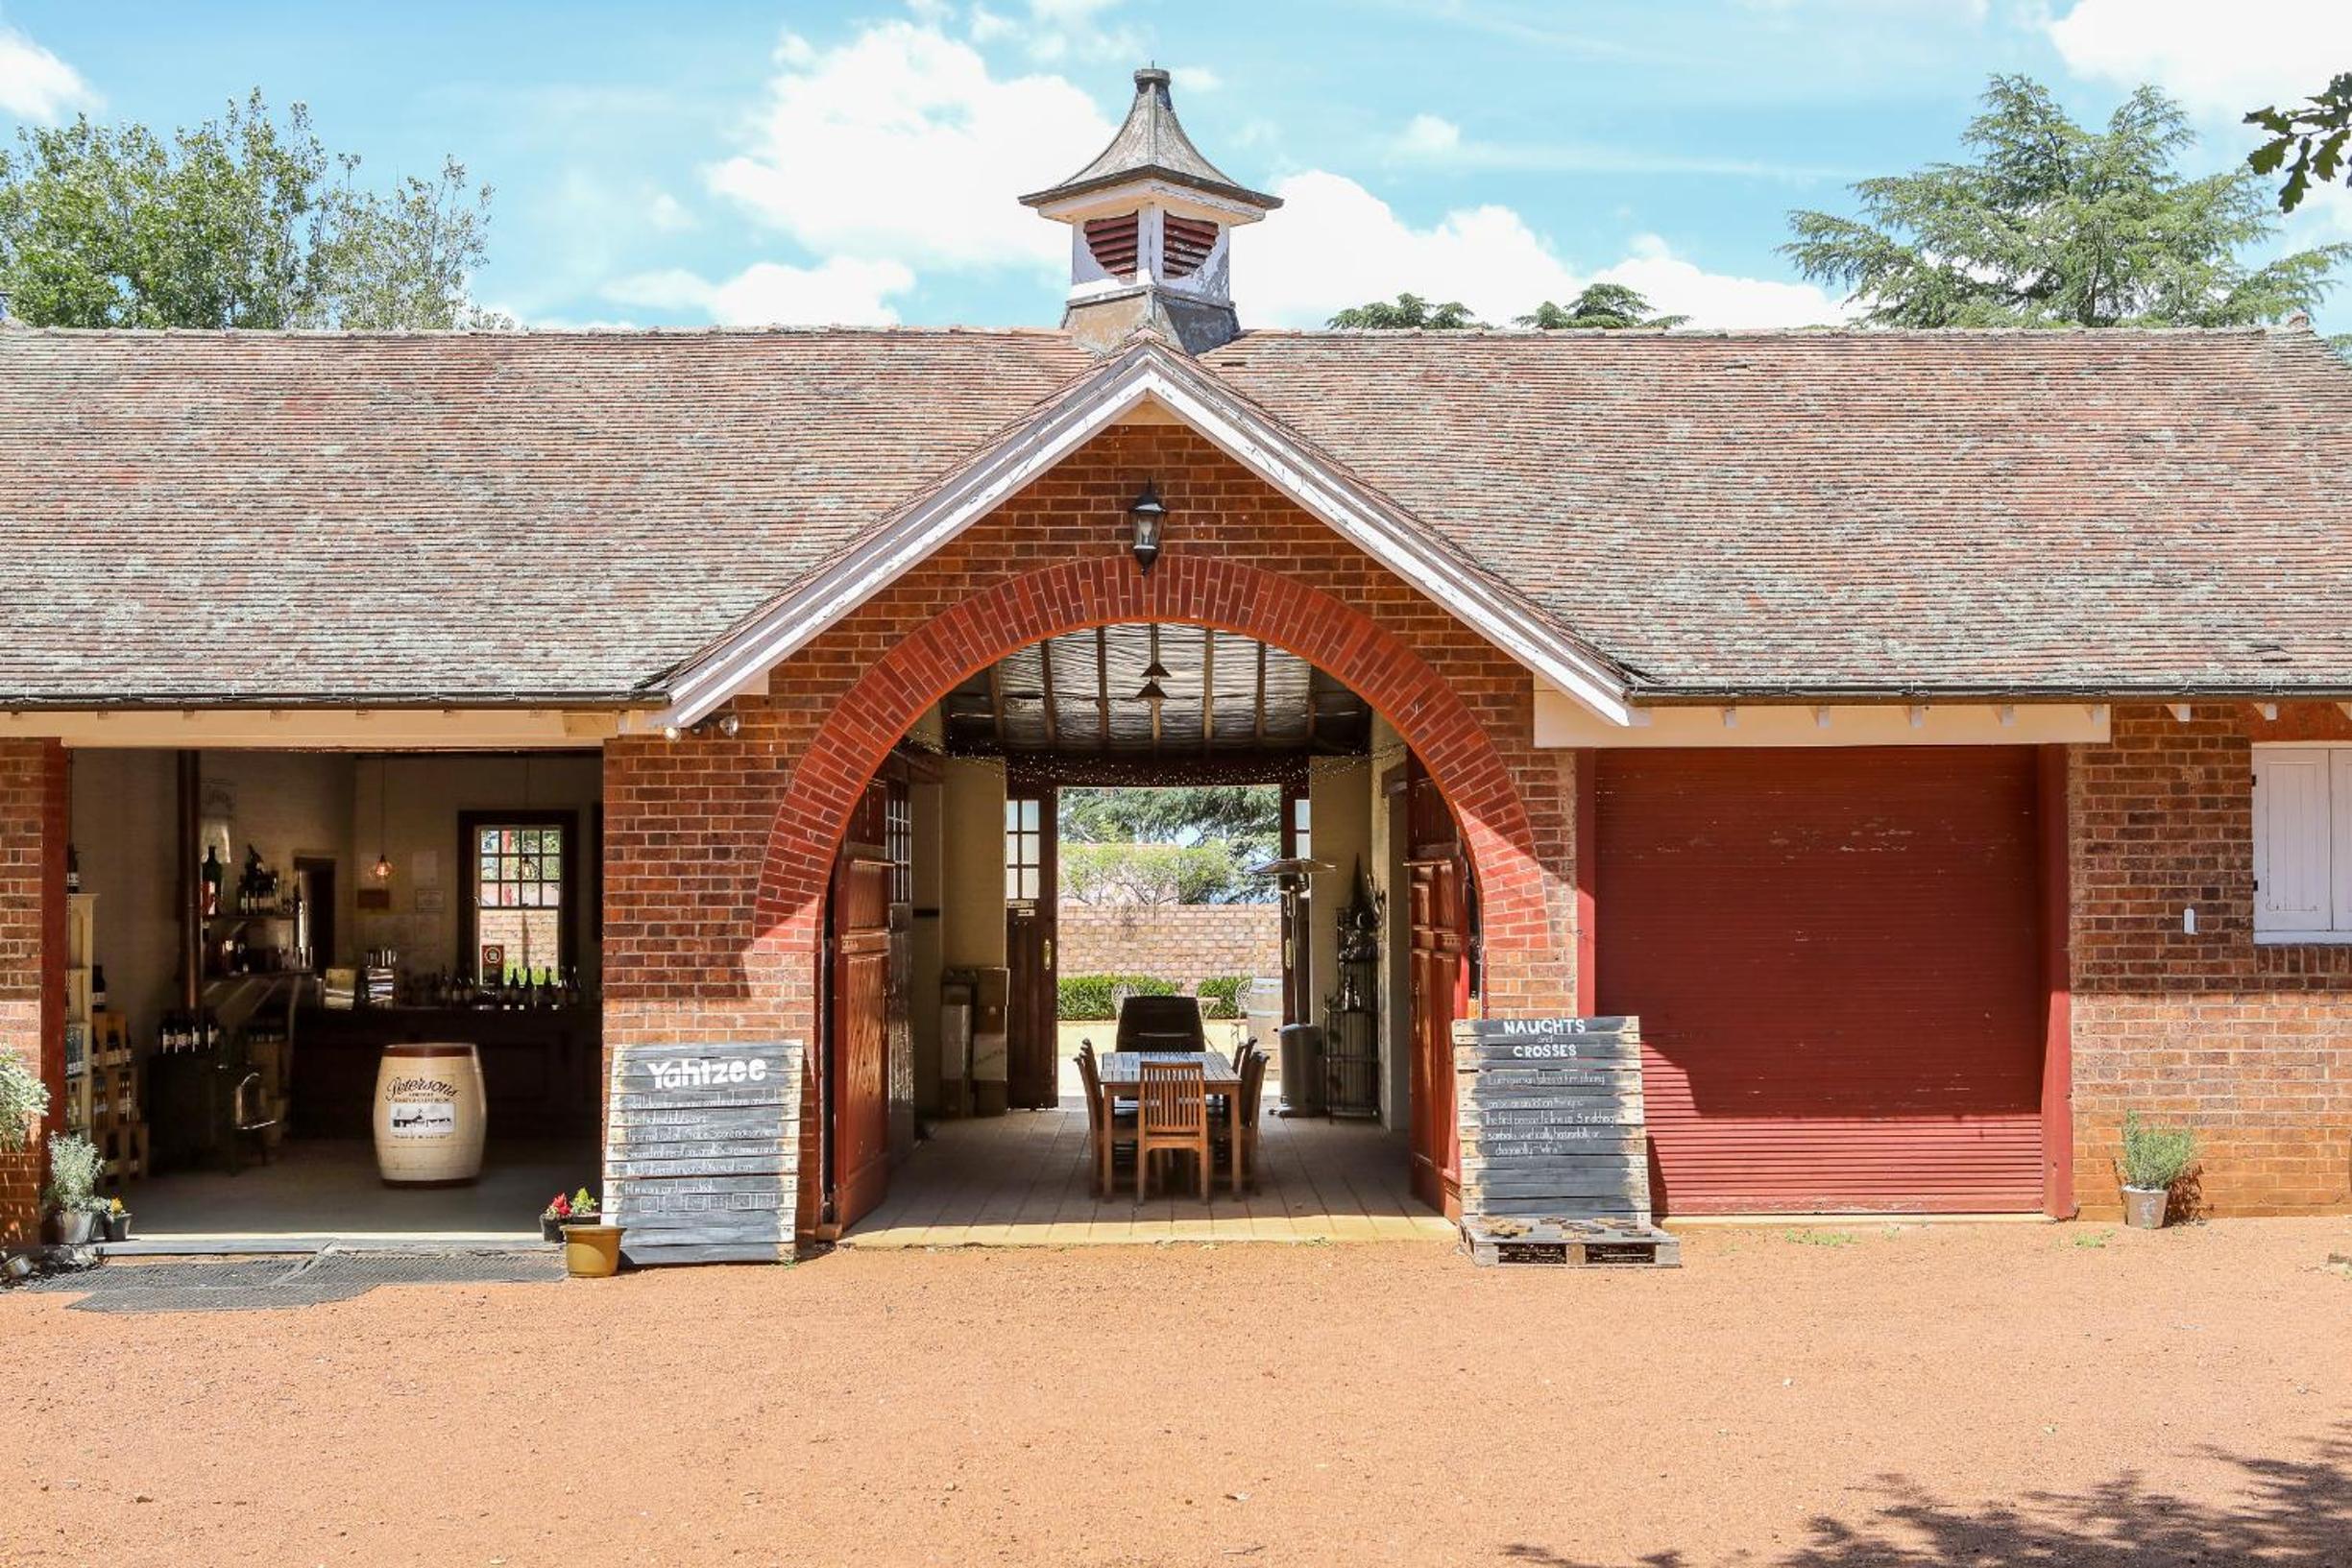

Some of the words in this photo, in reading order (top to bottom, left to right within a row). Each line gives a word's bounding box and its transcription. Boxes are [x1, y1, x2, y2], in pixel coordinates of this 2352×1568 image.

[1502, 1018, 1587, 1035] NAUGHTS
[1537, 1035, 1554, 1044] and
[1512, 1044, 1577, 1058] CROSSES
[646, 1058, 767, 1090] Yahtzee
[385, 1076, 461, 1101] Petersons
